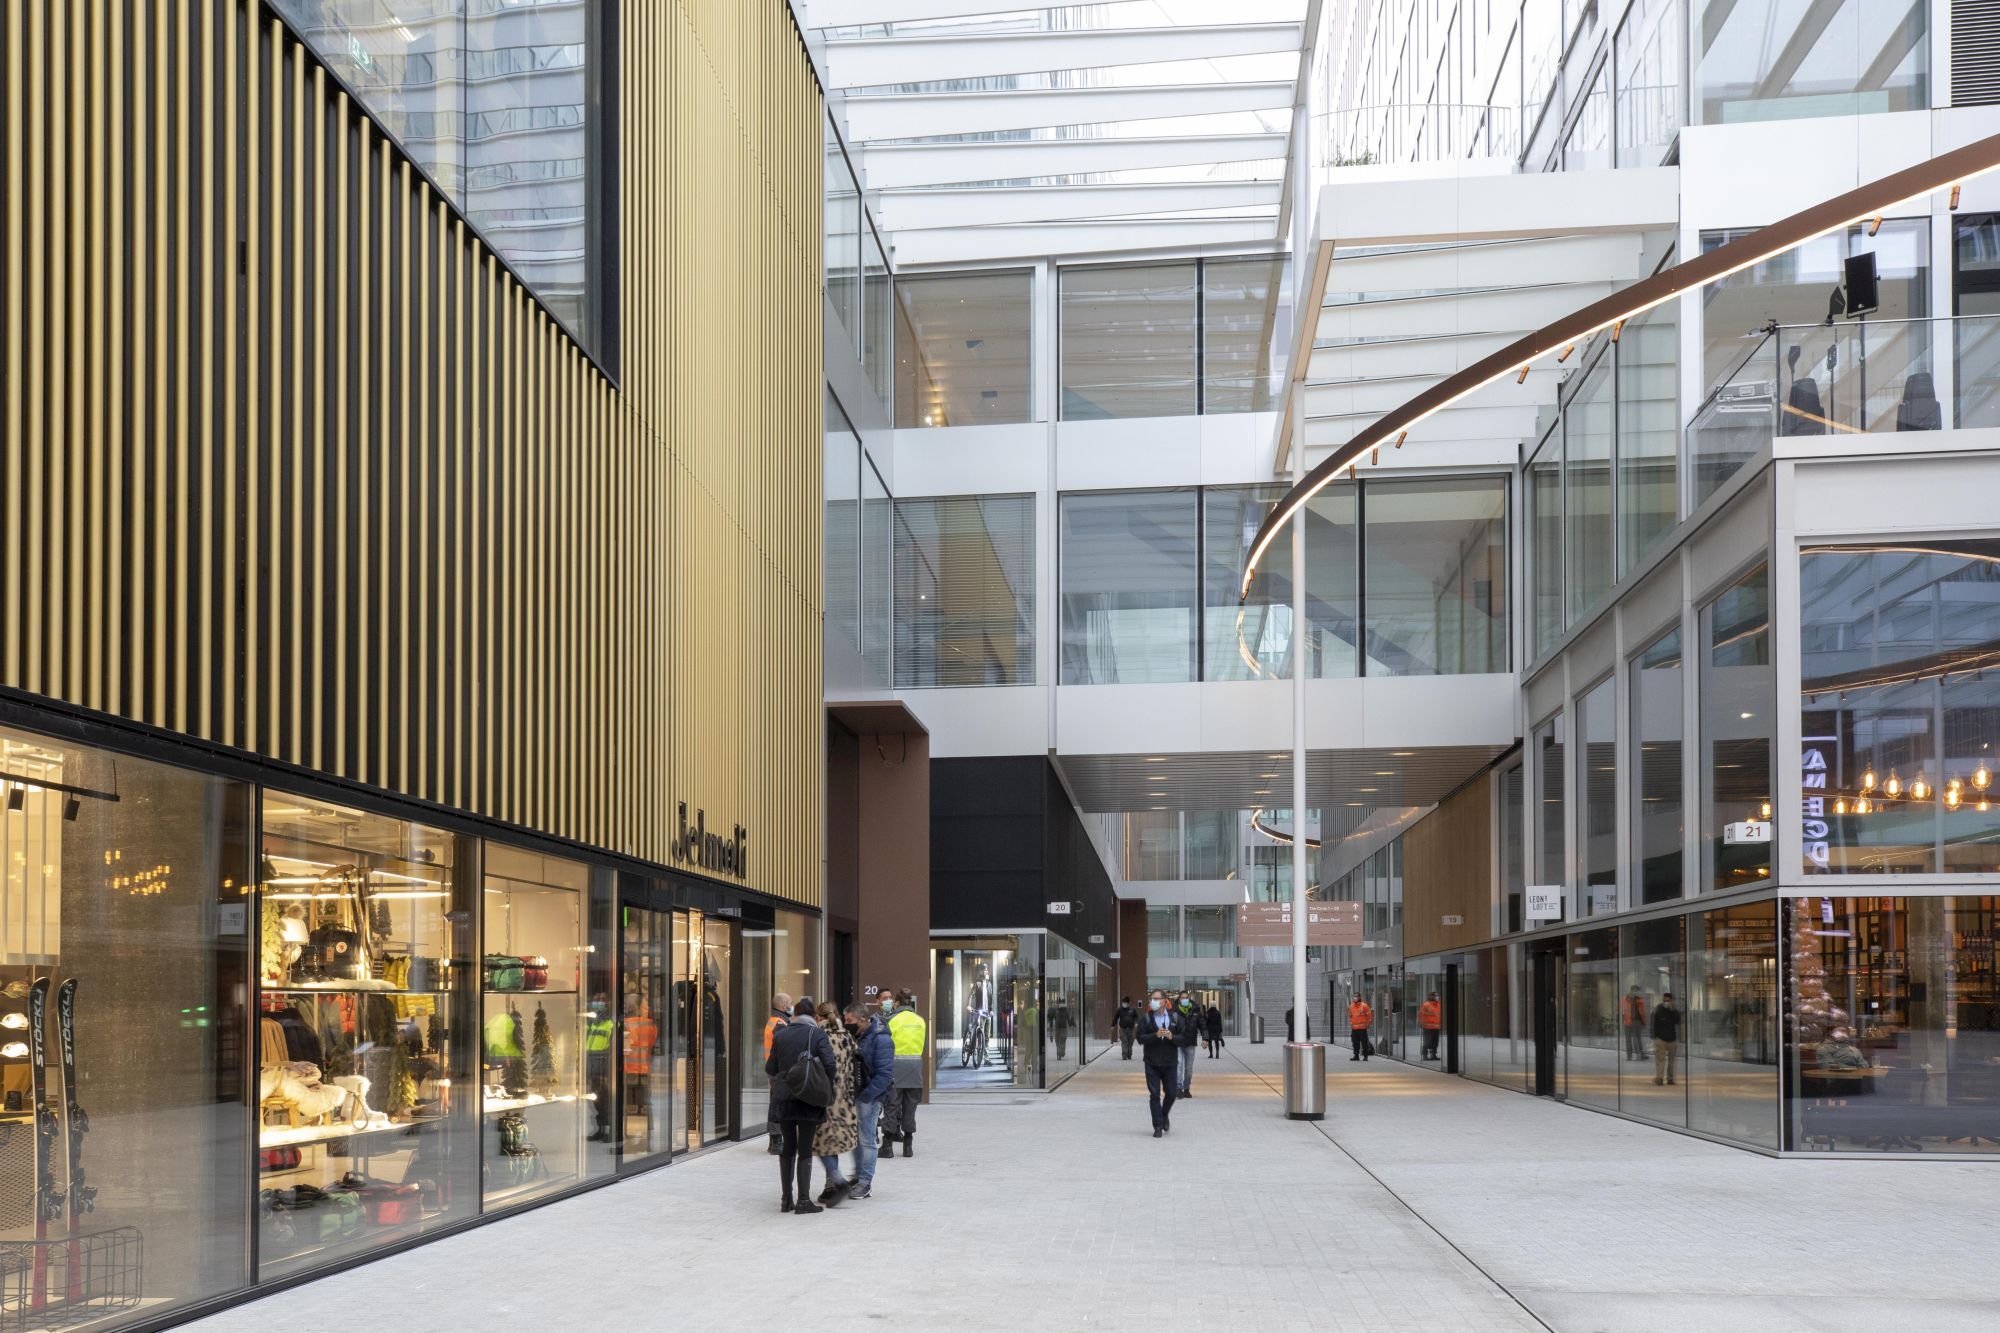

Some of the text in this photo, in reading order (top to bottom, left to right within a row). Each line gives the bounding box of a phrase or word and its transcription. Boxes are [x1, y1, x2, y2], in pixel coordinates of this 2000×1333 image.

[672, 800, 746, 880] Jelmoli
[1745, 826, 1761, 837] 21
[864, 985, 878, 995] 20
[33, 988, 44, 1068] STÖCKLI
